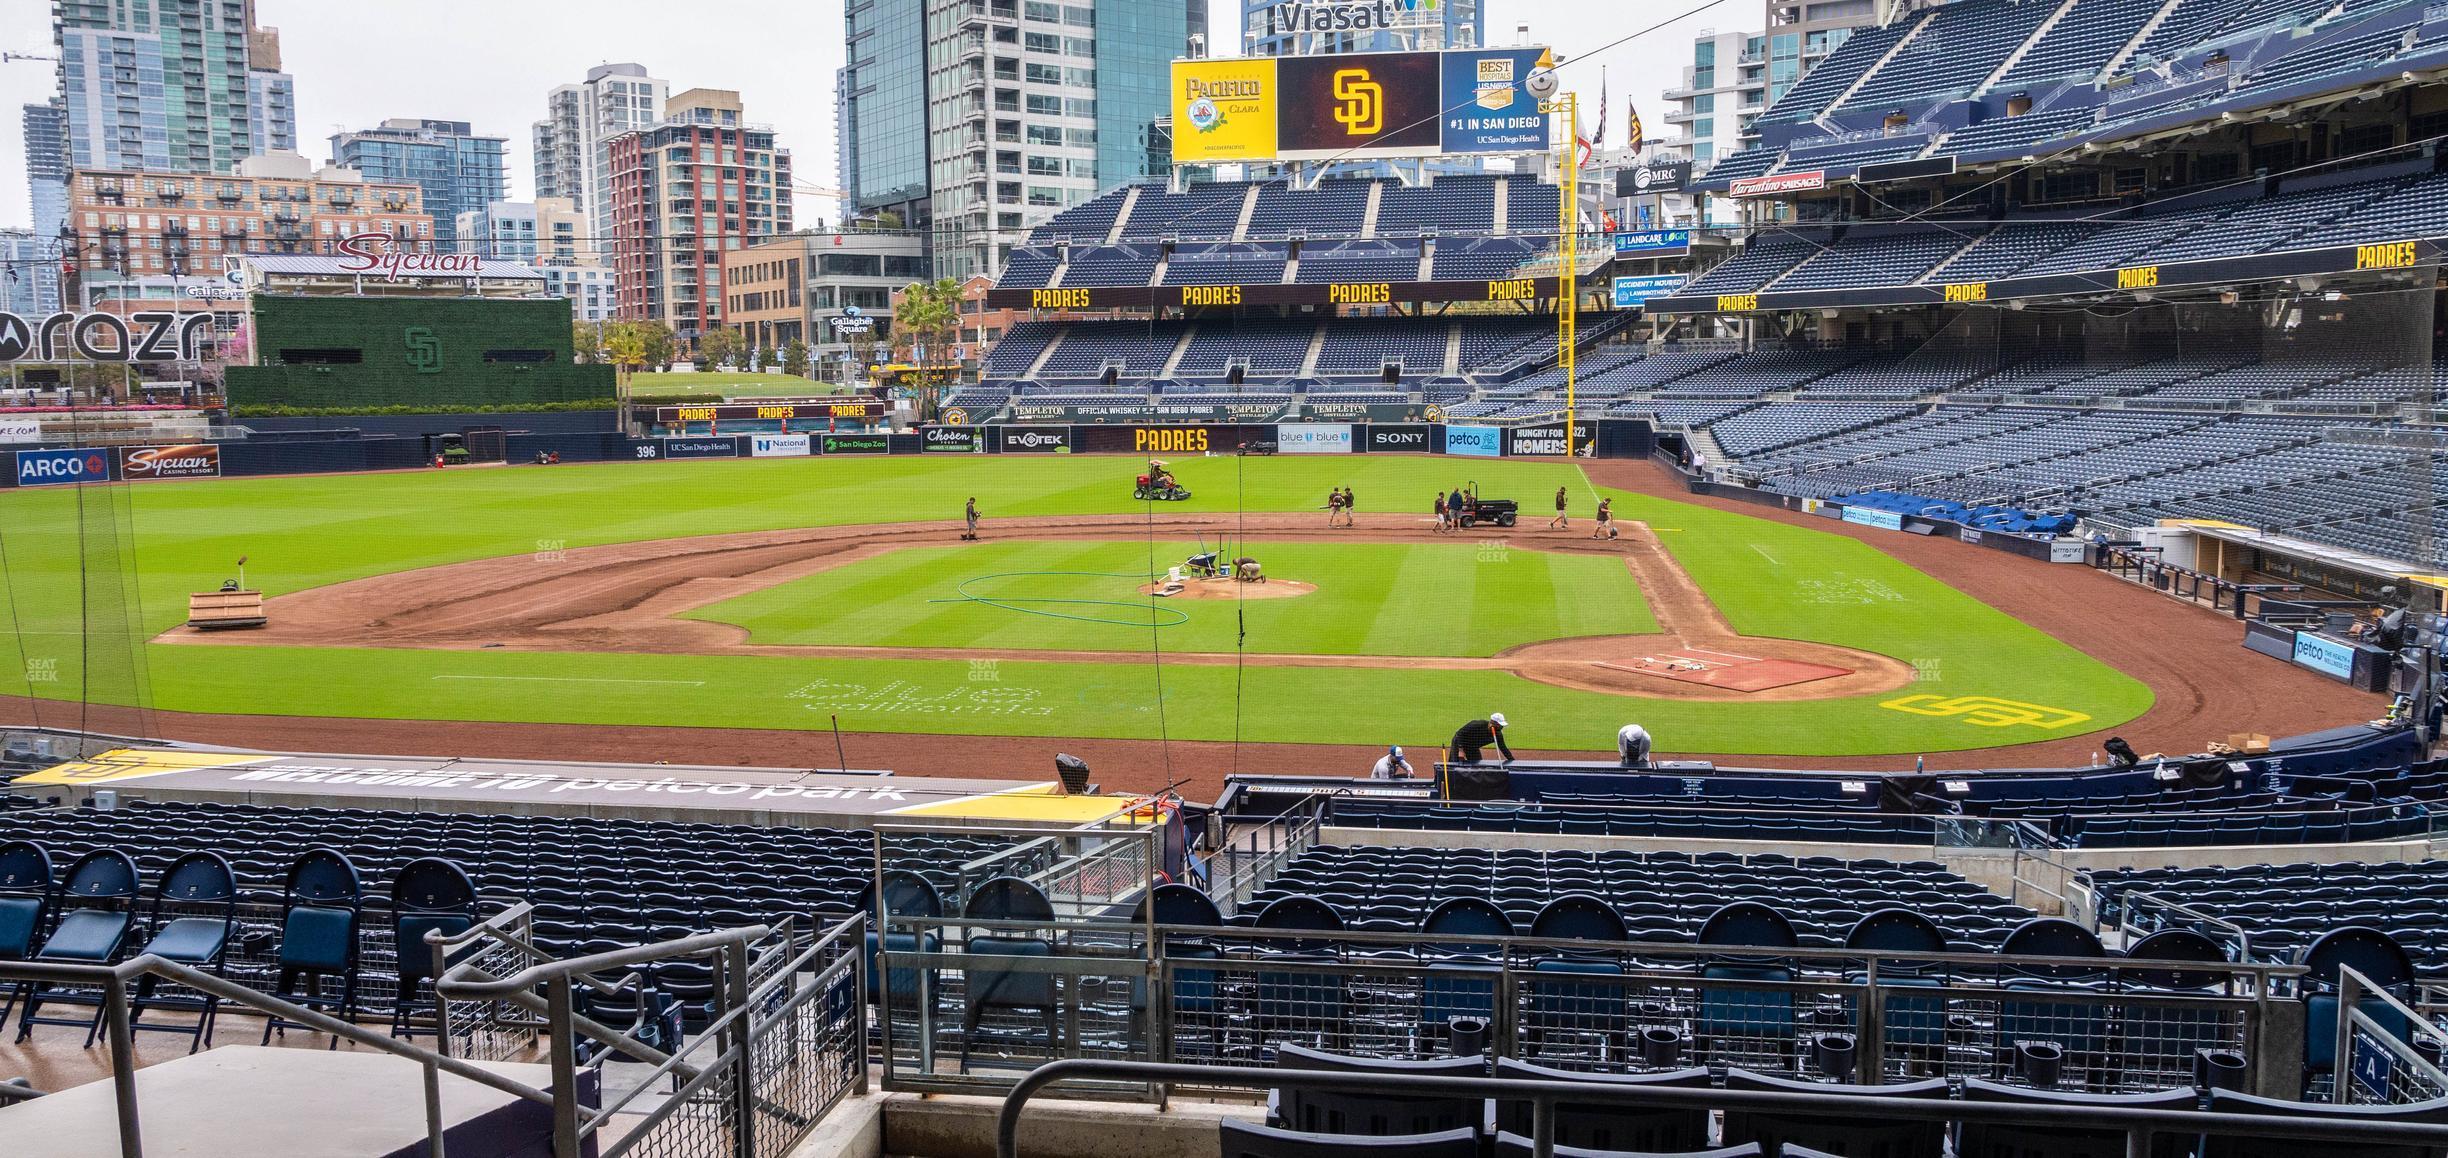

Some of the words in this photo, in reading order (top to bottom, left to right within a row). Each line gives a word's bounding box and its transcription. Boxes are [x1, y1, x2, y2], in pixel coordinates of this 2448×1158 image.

[1280, 0, 1390, 32] Viasat
[1479, 61, 1511, 73] BEST
[1479, 72, 1512, 81] HOSPITALS
[1333, 68, 1383, 135] SD
[1450, 119, 1463, 130] #1
[1468, 119, 1479, 130] IN
[1482, 118, 1505, 129] SAN
[1508, 116, 1540, 129] DIEGO
[1477, 136, 1488, 144] UC
[1500, 135, 1519, 145] Diego
[1519, 134, 1540, 142] Health
[1651, 168, 1676, 180] MRC
[1731, 180, 1780, 194] Tarantino
[1780, 177, 1821, 190] SAUSAGES
[1627, 233, 1663, 244] LANDCARE
[338, 232, 484, 282] Sycuan
[2357, 242, 2416, 269] PADRES
[2118, 267, 2158, 288] PADRES
[1033, 288, 1090, 308] PADRES
[1182, 285, 1240, 305] PADRES
[1329, 283, 1390, 303] PADRES
[1488, 278, 1535, 304] PADRES
[1946, 283, 1987, 301] PADRES
[1717, 294, 1757, 312] PADRES
[831, 317, 873, 326] Gallagher
[837, 324, 868, 333] Square
[831, 405, 866, 417] PADRES
[1014, 406, 1065, 416] TEMPLETON
[1077, 407, 1108, 415] OFFICIAL
[1108, 406, 1141, 415] WHISKEY
[1156, 406, 1170, 414] SAN
[1170, 406, 1189, 414] DIEGO
[1189, 406, 1214, 414] PADRES
[1225, 405, 1279, 414] TEMPLETON
[1312, 404, 1367, 414] TEMPLETON
[927, 429, 970, 441] Chosen
[1008, 433, 1062, 447] EVOTEK
[1135, 428, 1208, 451] PADRES
[1280, 431, 1303, 442] blue
[1316, 431, 1339, 442] blue
[1376, 433, 1423, 443] SONY
[1516, 428, 1548, 438] HUNGRY
[1548, 428, 1564, 438] FOR
[694, 443, 711, 452] Diego
[711, 442, 731, 450] Health
[772, 438, 806, 447] National
[839, 440, 852, 448] San
[853, 440, 871, 448] Diego
[1450, 433, 1480, 448] petco
[1513, 439, 1568, 454] HOMERS
[637, 445, 656, 458] 396
[21, 457, 84, 478] ARCO
[127, 450, 210, 475] Sycuan
[163, 467, 187, 475] CASINO
[2296, 641, 2323, 660] petco
[229, 765, 474, 787] WELCOME
[549, 775, 752, 795] petco
[748, 783, 907, 800] park
[838, 990, 845, 1010] A
[2366, 1056, 2376, 1080] A
